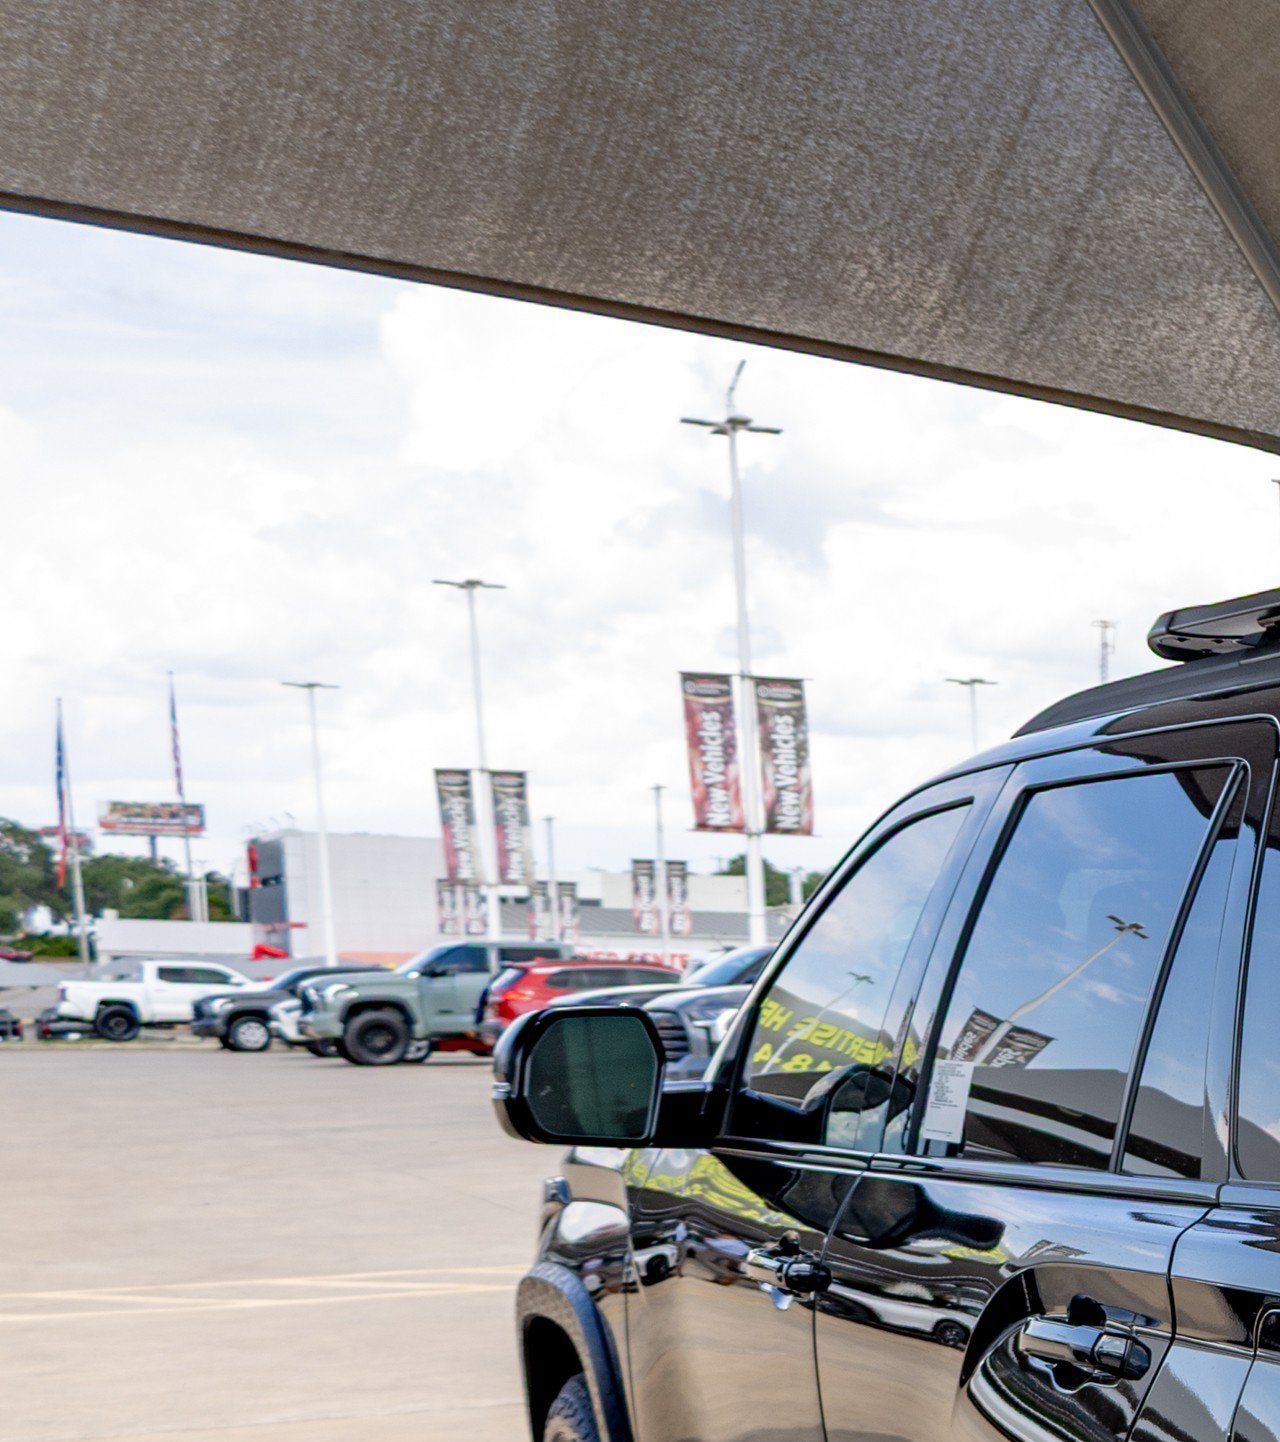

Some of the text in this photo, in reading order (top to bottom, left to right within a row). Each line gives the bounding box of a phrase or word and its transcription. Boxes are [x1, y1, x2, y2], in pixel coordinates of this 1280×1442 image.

[697, 711, 726, 784] Vehicles
[770, 715, 798, 788] Vehicles
[706, 787, 731, 826] New
[775, 790, 800, 829] New
